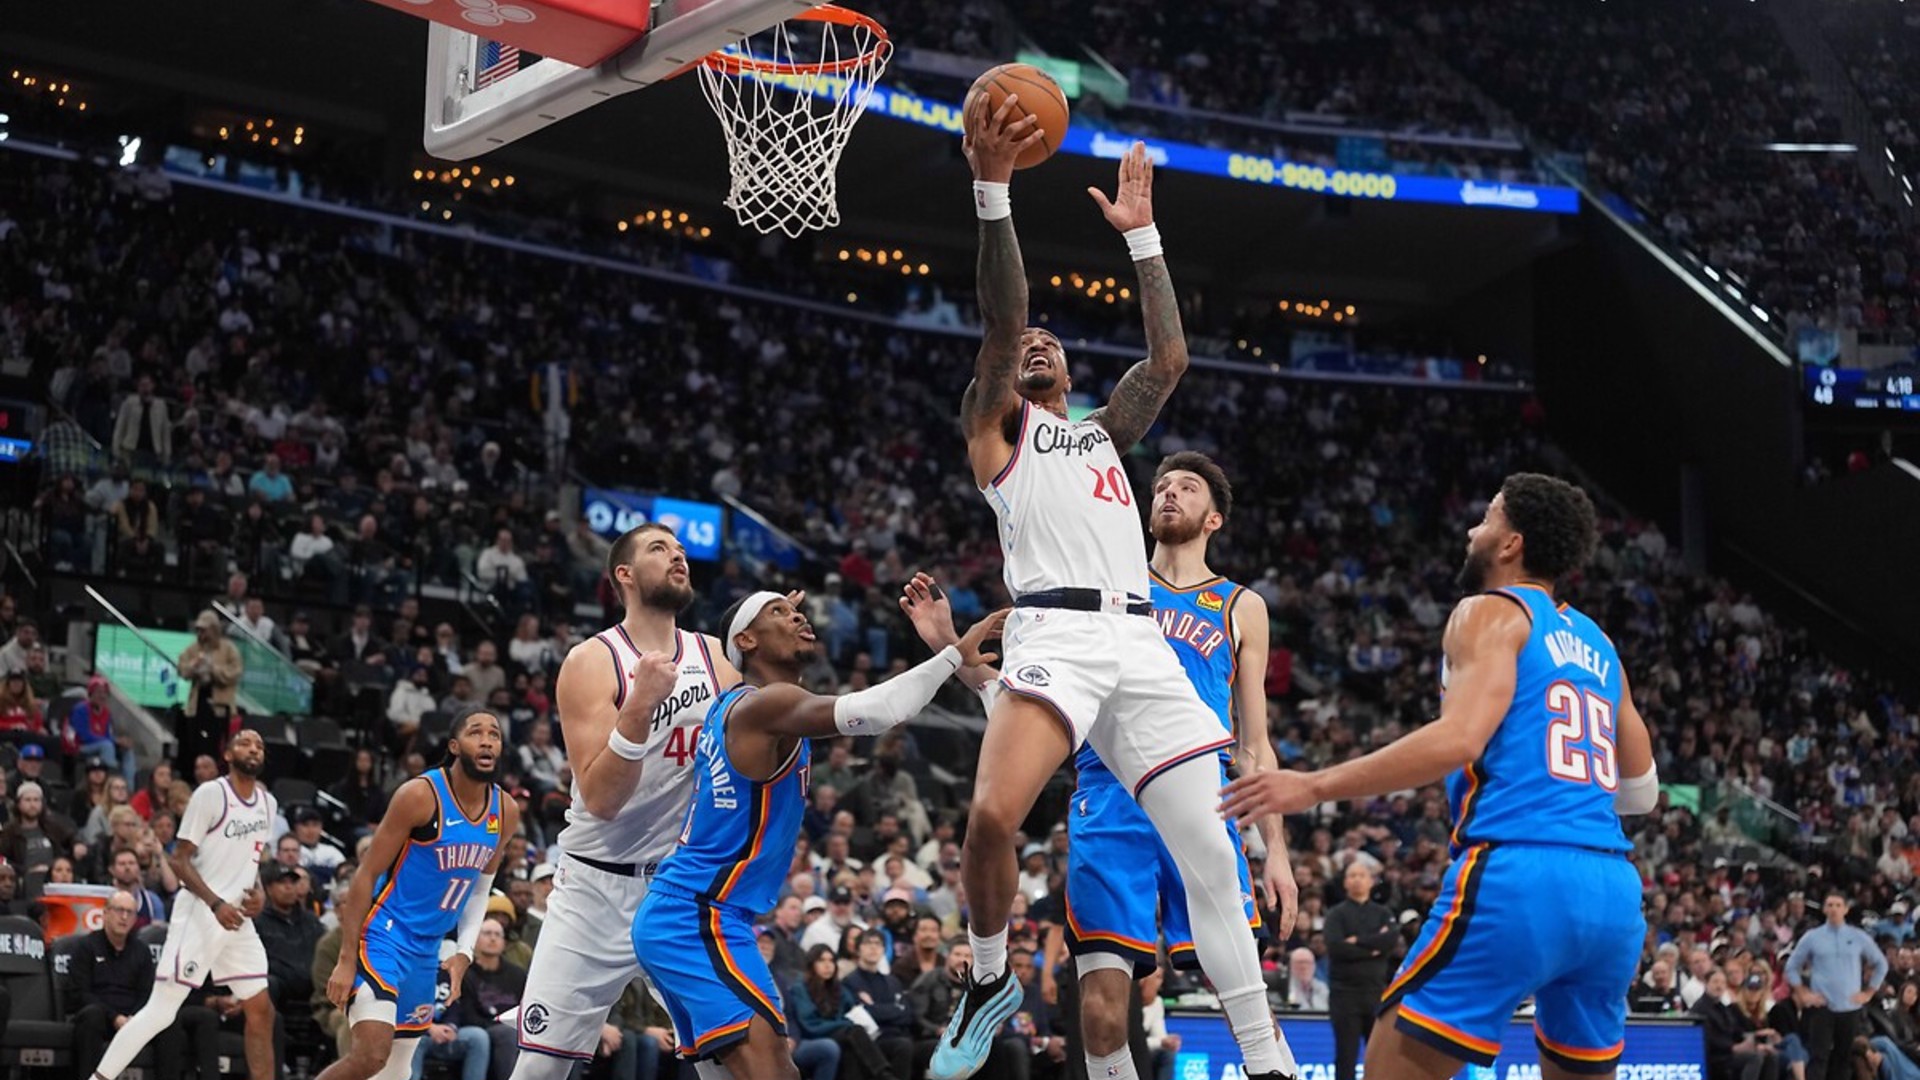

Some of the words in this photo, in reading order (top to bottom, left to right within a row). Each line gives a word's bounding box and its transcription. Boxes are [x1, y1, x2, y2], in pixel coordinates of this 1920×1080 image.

[889, 90, 964, 132] INJU
[1228, 153, 1397, 200] 800-900-0000
[1085, 462, 1131, 508] 20
[1150, 606, 1225, 658] NDER
[650, 681, 711, 732] ppers
[1546, 679, 1620, 793] 25
[439, 878, 472, 912] 11
[0, 933, 13, 954] HE
[54, 954, 72, 974] GE
[1615, 1063, 1702, 1080] EXPRESS
